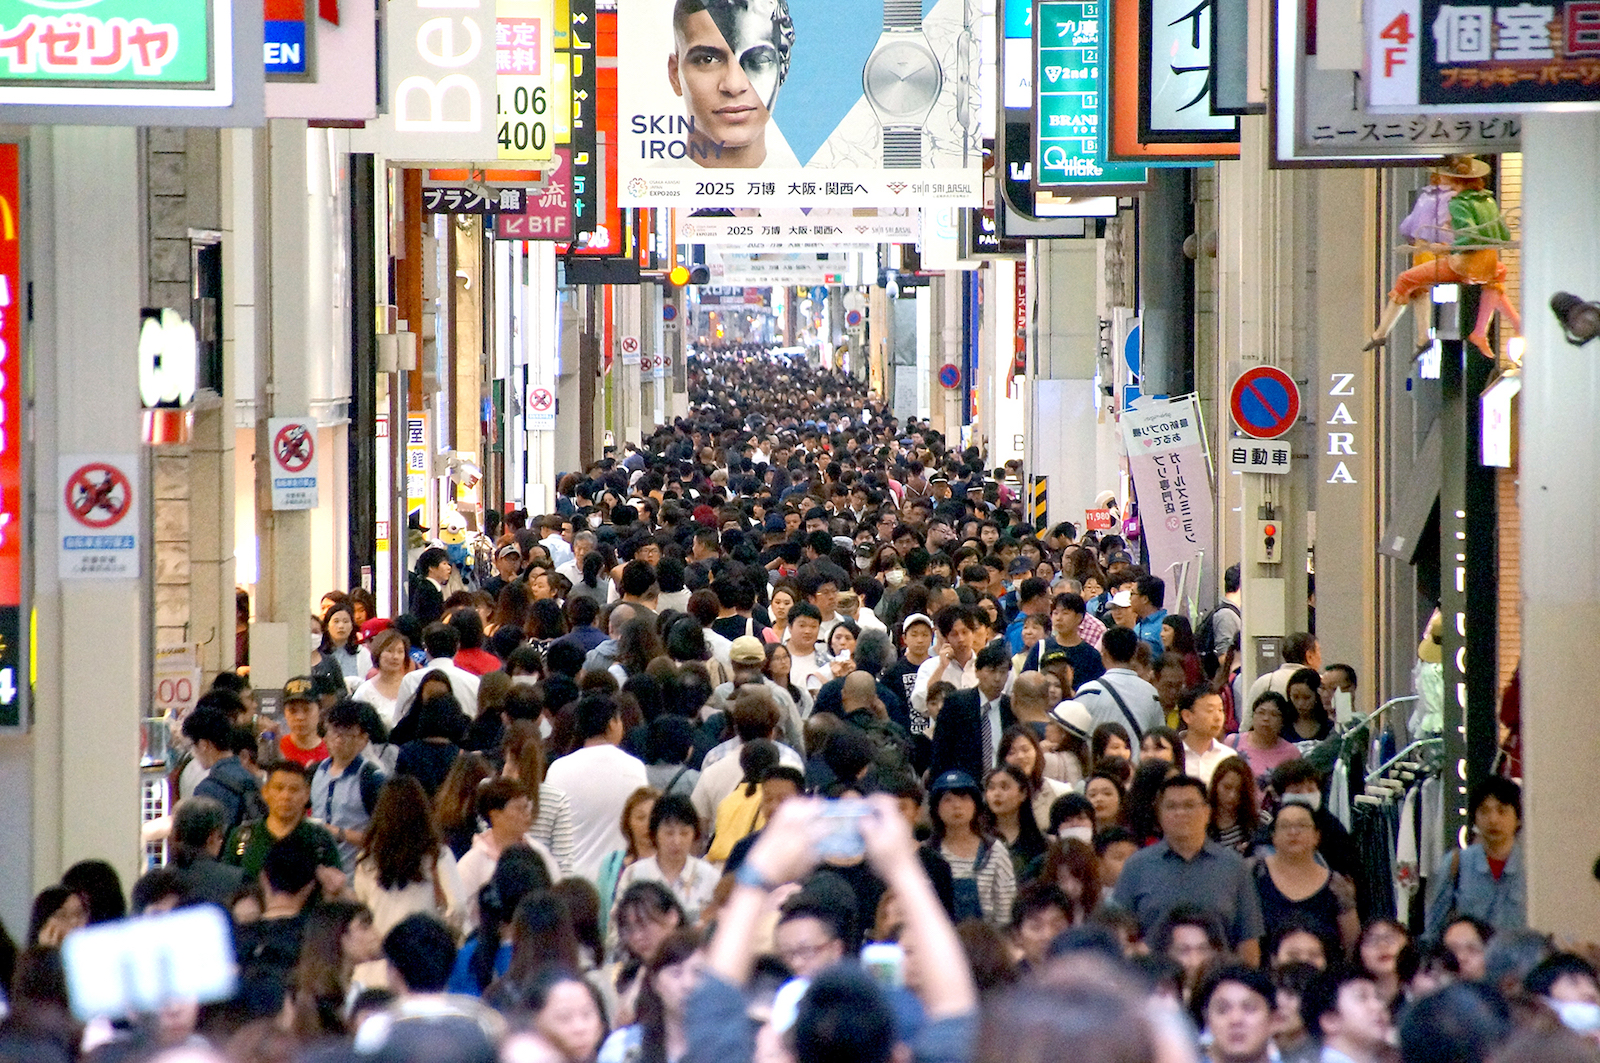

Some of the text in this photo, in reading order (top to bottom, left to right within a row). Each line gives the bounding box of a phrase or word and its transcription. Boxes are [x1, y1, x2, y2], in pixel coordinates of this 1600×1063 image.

[395, 0, 482, 132] Be
[1062, 67, 1088, 79] 2nd
[631, 115, 695, 134] SKIN
[641, 140, 725, 159] IRONY
[695, 182, 735, 195] 2025
[747, 182, 776, 195] 万博
[528, 216, 566, 233] B1F
[727, 226, 754, 236] 2025
[761, 226, 781, 236] 万博
[1018, 288, 1026, 330] レストラ
[1327, 373, 1357, 484] ZARA
[1232, 447, 1288, 466] 自動車
